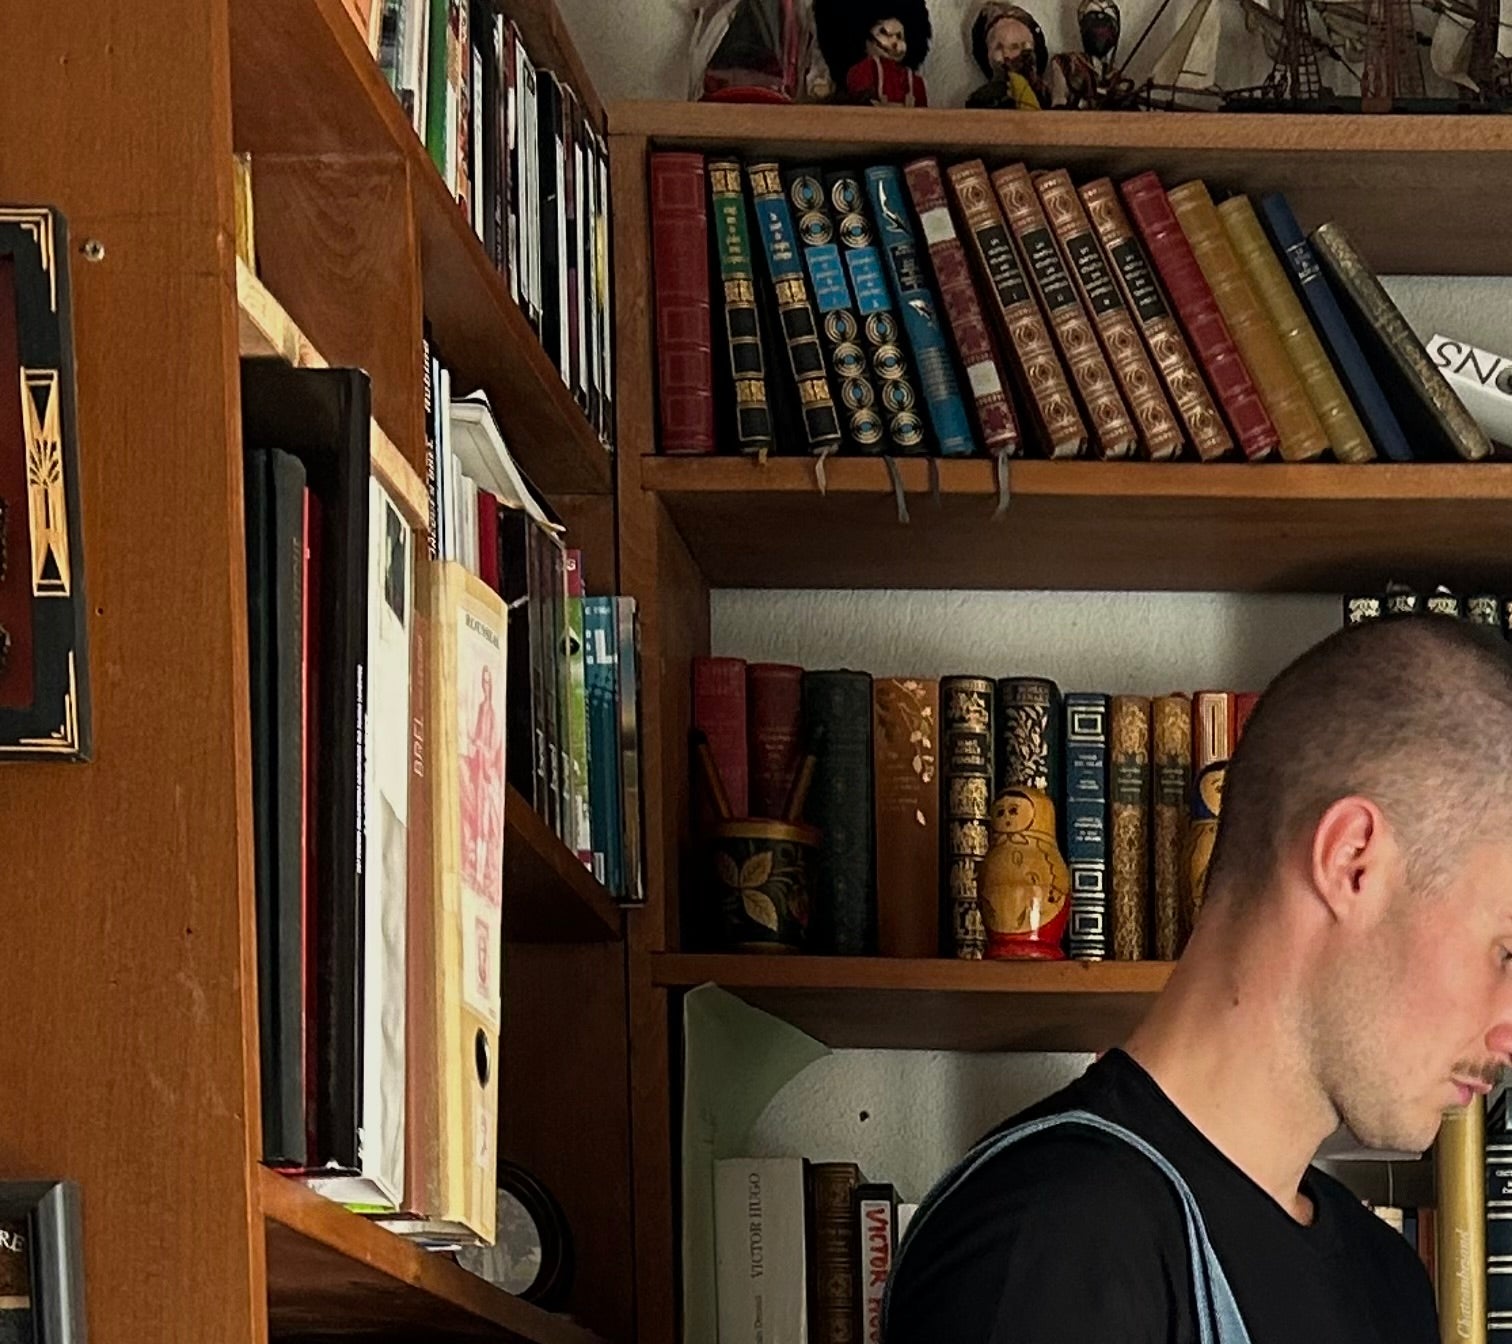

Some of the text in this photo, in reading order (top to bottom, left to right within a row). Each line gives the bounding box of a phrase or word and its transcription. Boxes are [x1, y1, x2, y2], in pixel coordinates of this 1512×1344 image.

[748, 1173, 763, 1279] VICTOR HUGO
[866, 1207, 889, 1287] VICTOR
